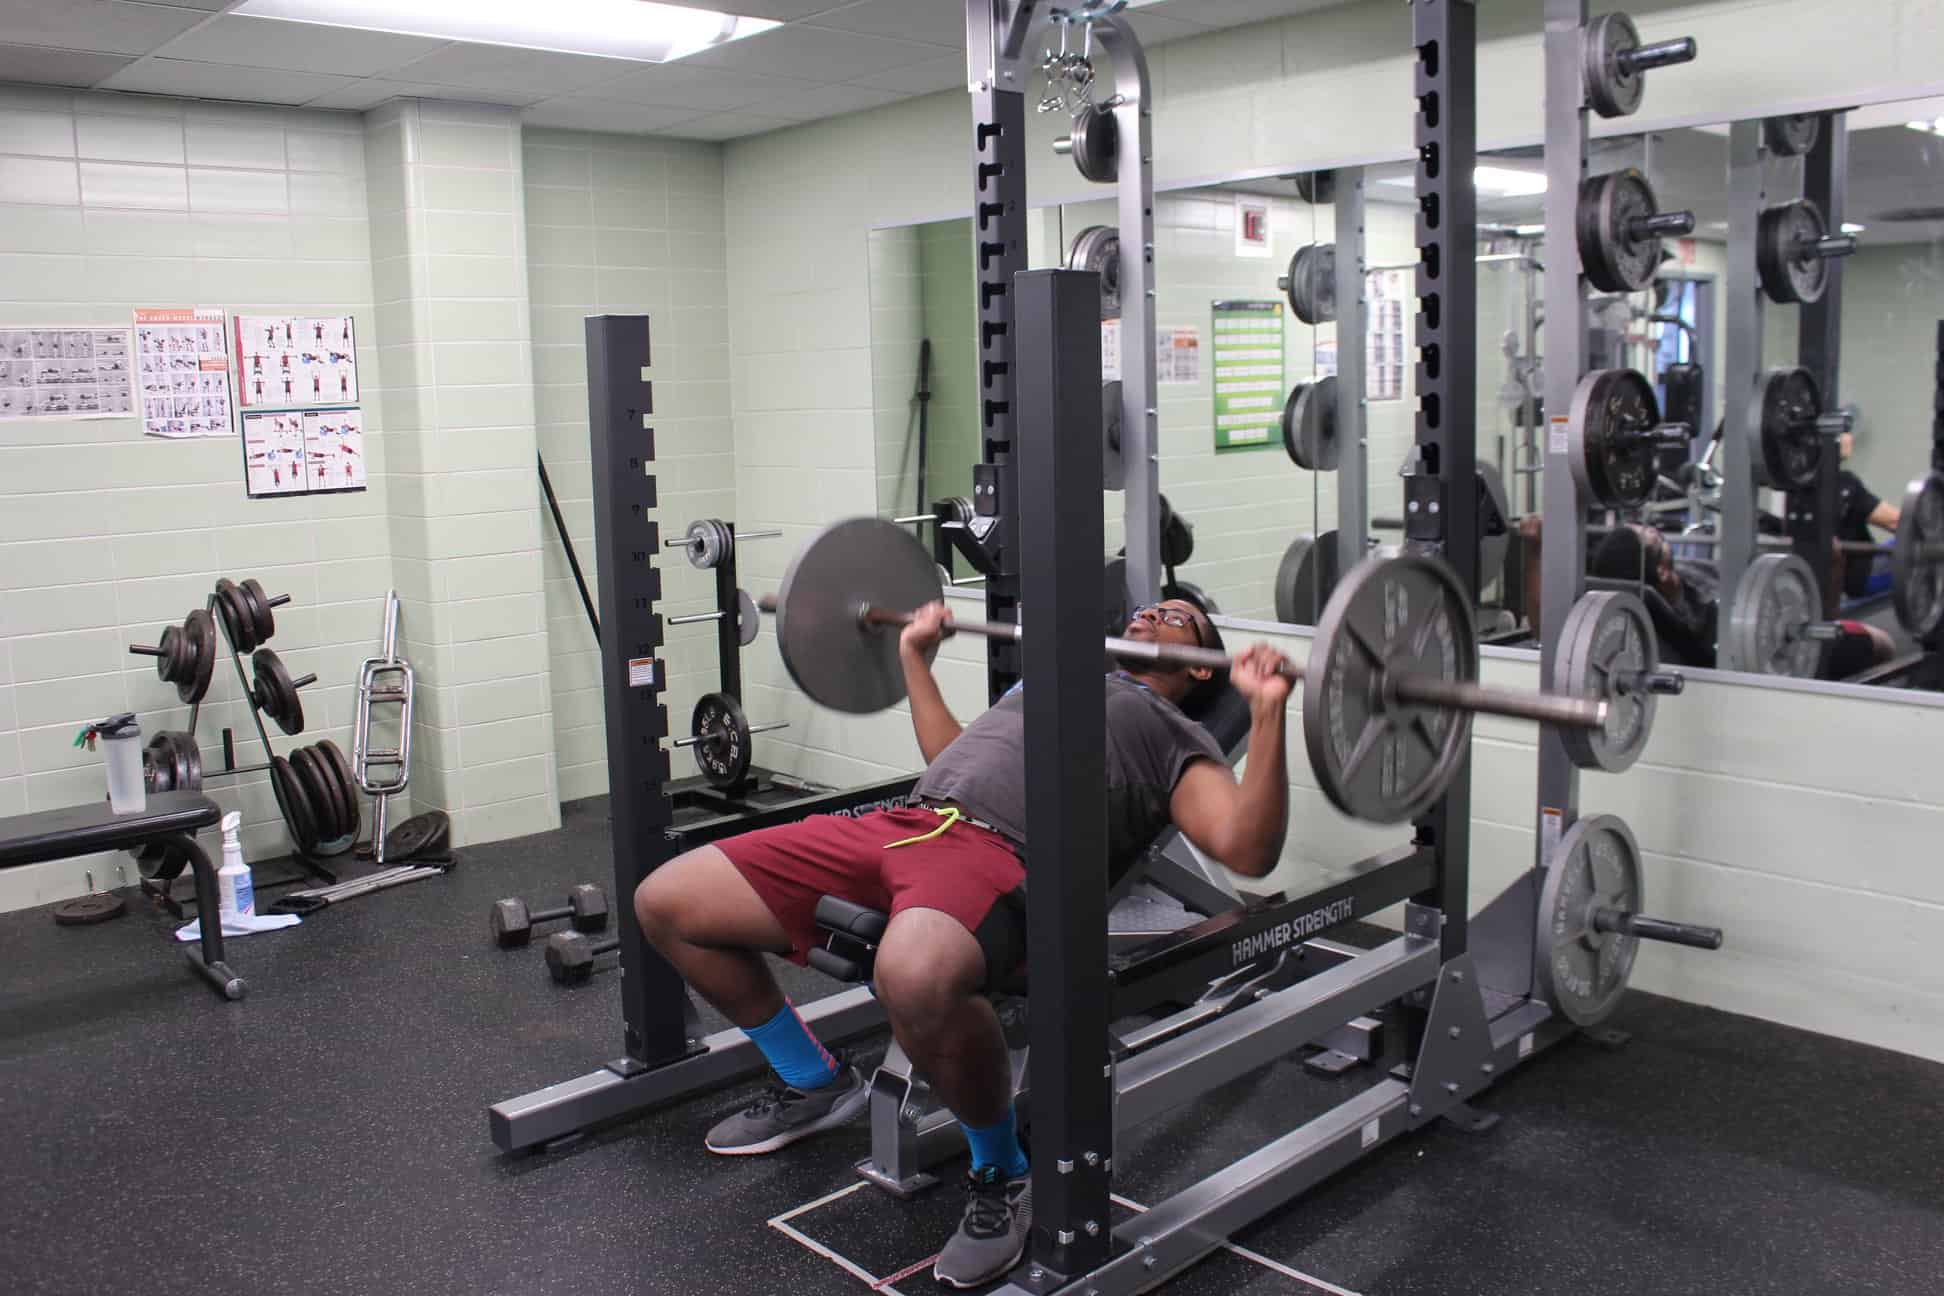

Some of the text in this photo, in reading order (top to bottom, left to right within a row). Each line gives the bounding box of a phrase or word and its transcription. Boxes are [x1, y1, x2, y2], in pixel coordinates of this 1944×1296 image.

[627, 408, 636, 420] 7
[631, 503, 641, 515] 9
[631, 551, 646, 562] 10
[633, 598, 647, 609] 11
[1232, 896, 1353, 967] HAMMER STRENGTH
